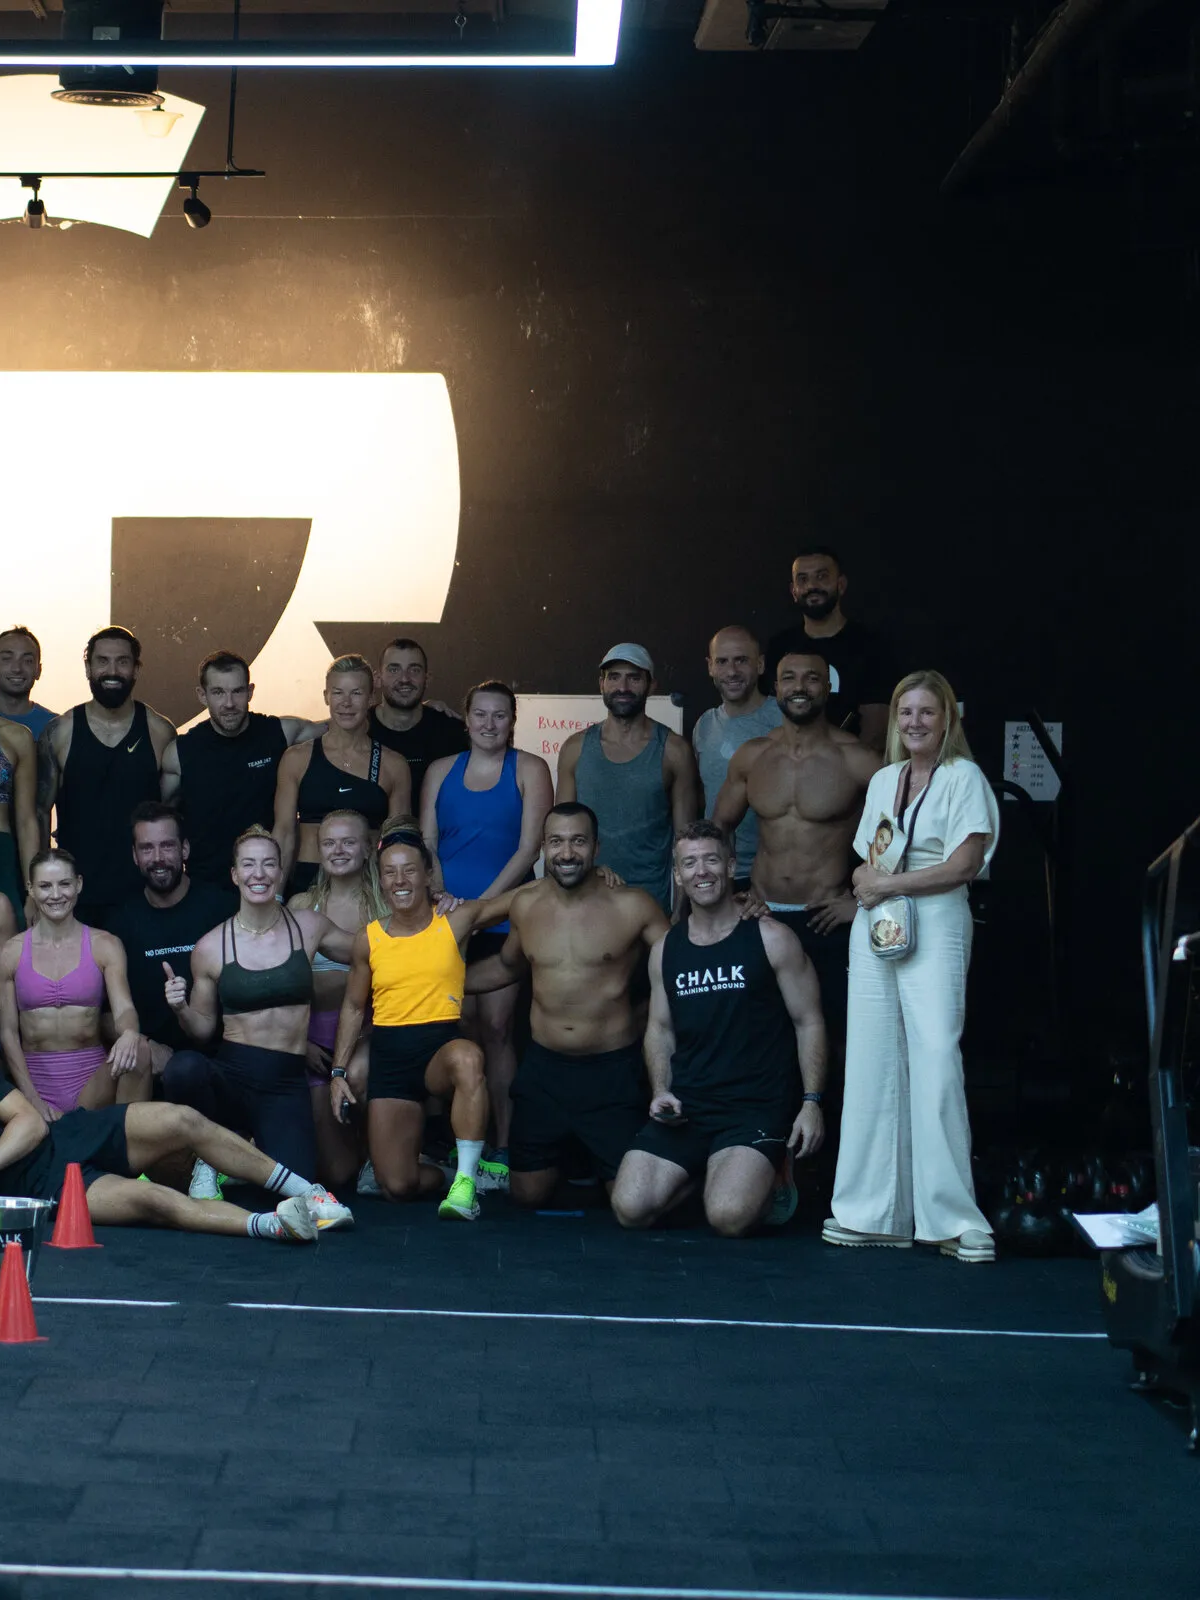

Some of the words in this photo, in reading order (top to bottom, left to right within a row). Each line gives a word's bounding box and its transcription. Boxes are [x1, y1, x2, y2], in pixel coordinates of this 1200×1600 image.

[675, 965, 745, 989] CHALK
[676, 986, 709, 997] TRAINING
[711, 982, 745, 991] GROUND
